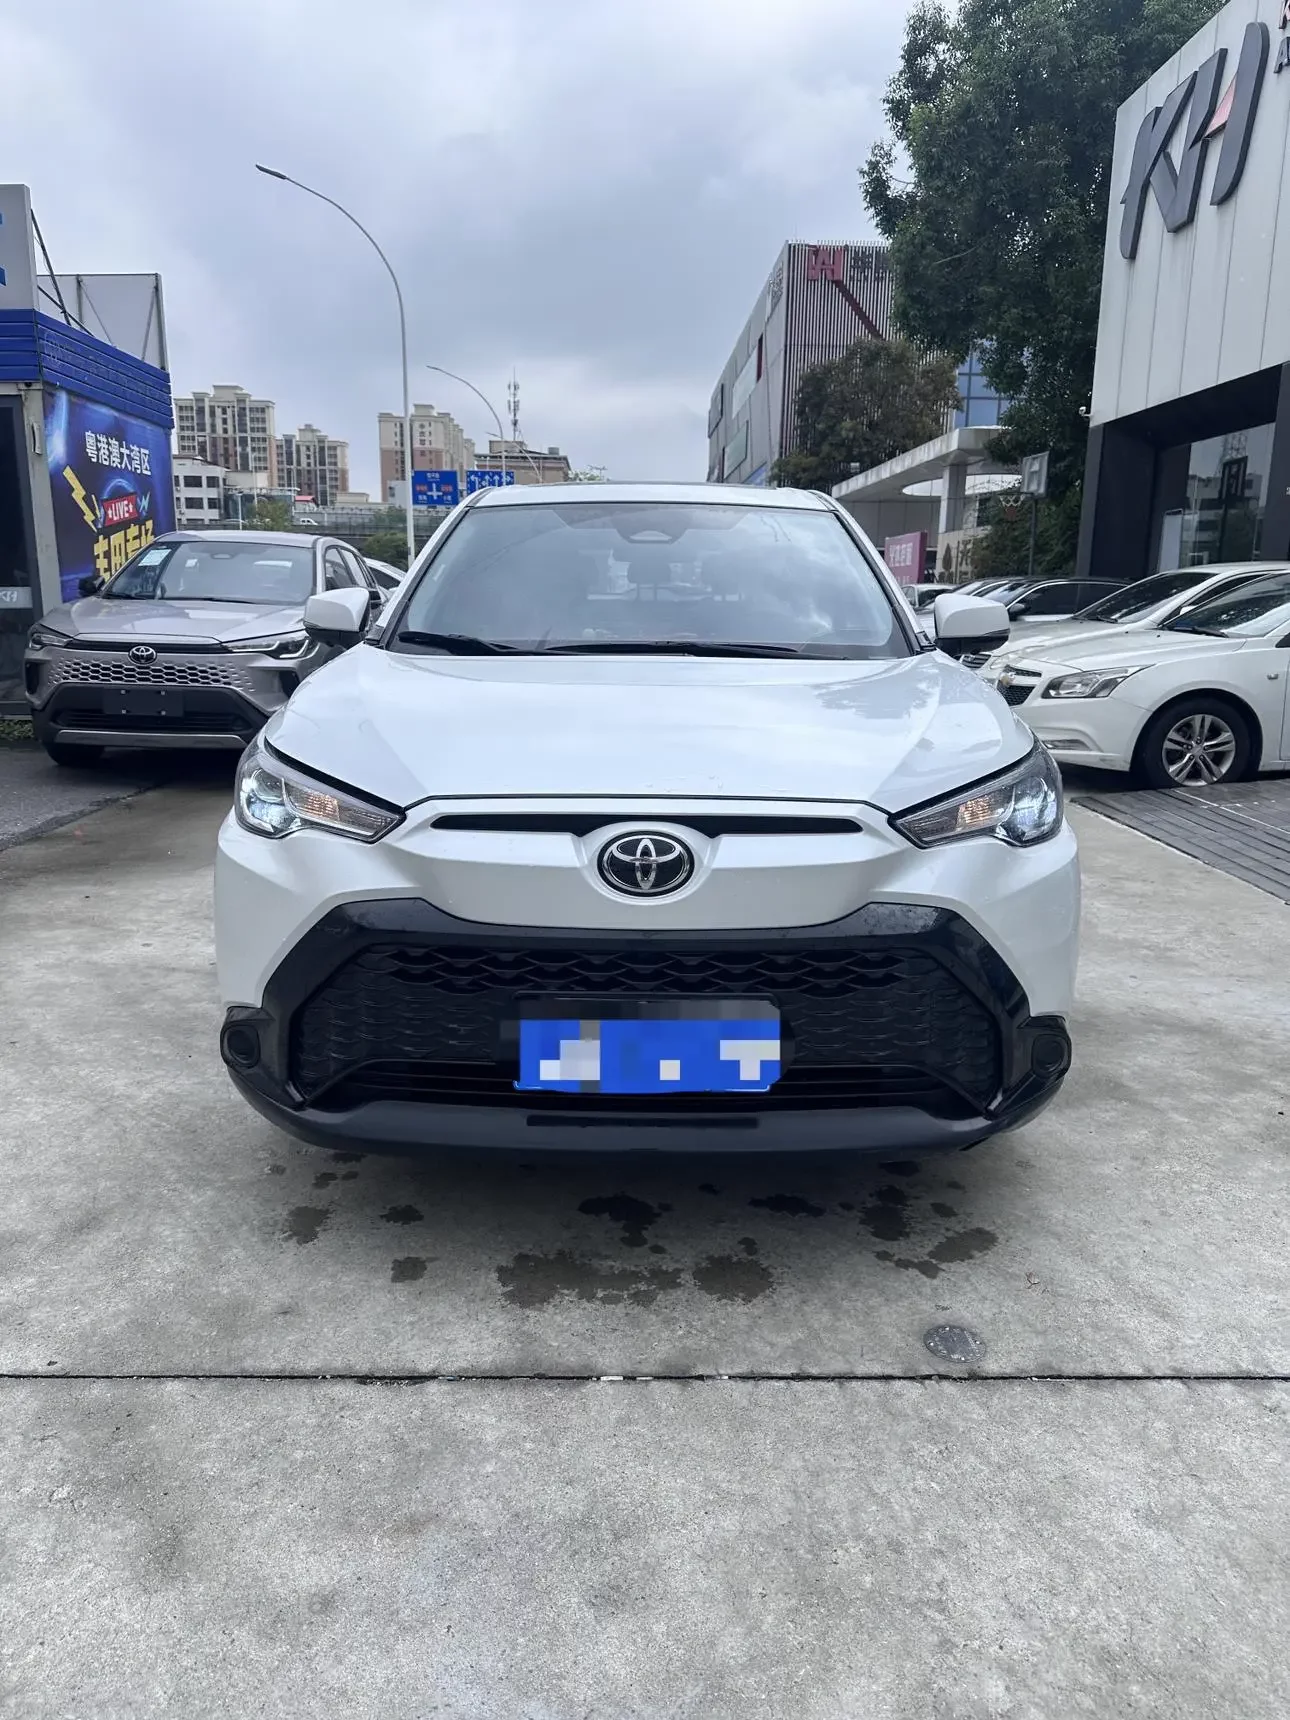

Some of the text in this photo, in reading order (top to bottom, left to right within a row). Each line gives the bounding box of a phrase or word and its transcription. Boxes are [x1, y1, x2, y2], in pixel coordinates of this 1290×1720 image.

[85, 431, 152, 475] 粤港澳大湾区
[111, 500, 130, 521] LIVE
